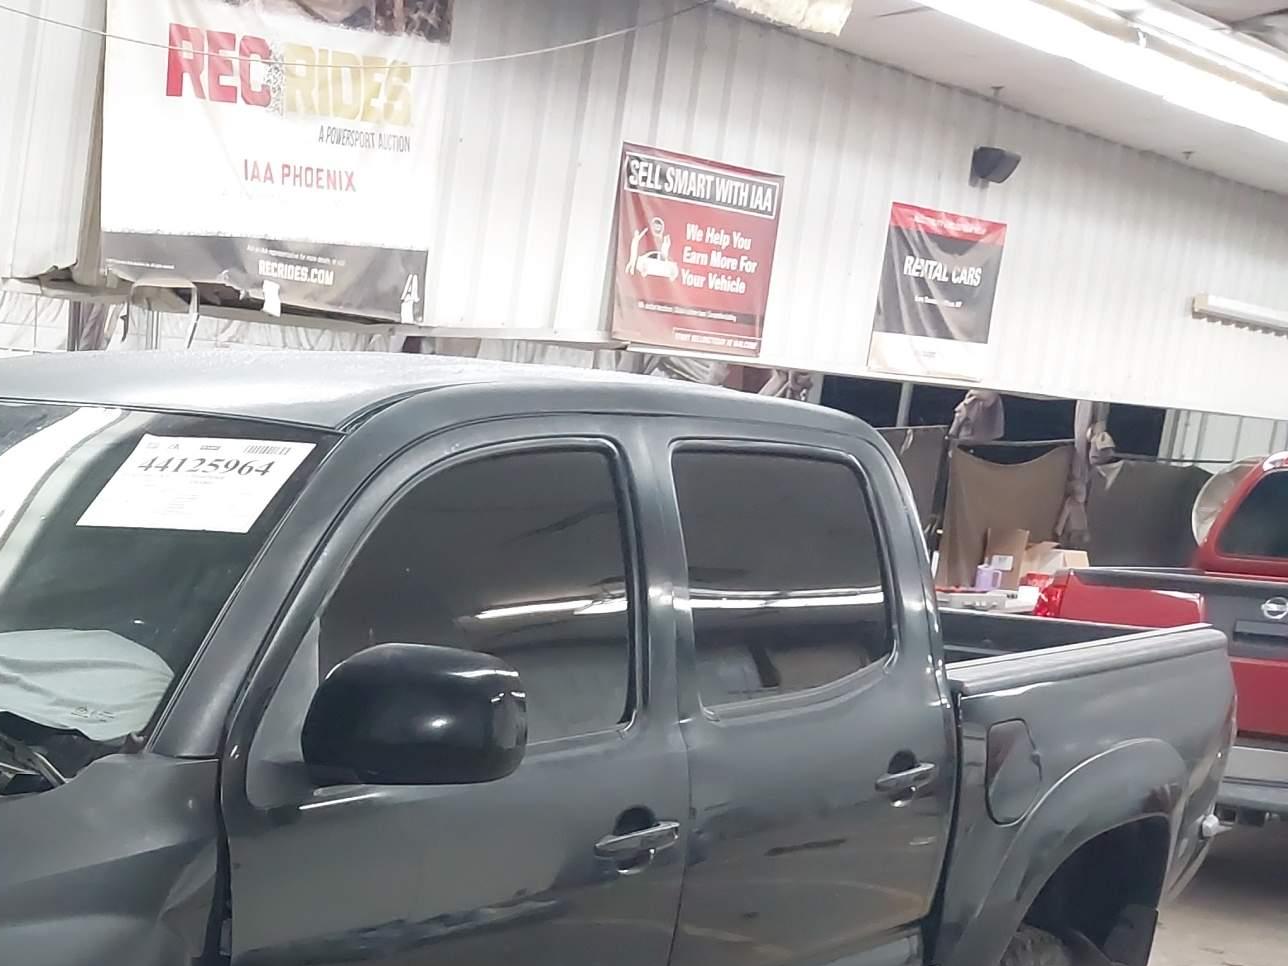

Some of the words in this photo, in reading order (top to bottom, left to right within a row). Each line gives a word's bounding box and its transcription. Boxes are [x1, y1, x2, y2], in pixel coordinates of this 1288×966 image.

[166, 23, 272, 108] REC
[283, 42, 412, 126] RIDES
[326, 126, 376, 149] POWERSPORT
[378, 132, 411, 153] AUCTION
[244, 159, 275, 185] IAA
[281, 163, 357, 192] PHOENIX
[629, 159, 662, 191] SELL
[665, 166, 714, 200] SMART
[715, 176, 750, 208] WITH
[751, 184, 773, 212] IAA
[686, 223, 704, 242] We
[705, 227, 731, 250] Help
[732, 231, 752, 250] You
[682, 246, 709, 266] Earn
[710, 250, 738, 271] More
[739, 255, 758, 273] For
[903, 256, 949, 282] RENTAL
[951, 266, 982, 286] CARS
[681, 268, 706, 288] Your
[708, 272, 746, 294] Vehicle
[138, 455, 276, 477] 44125964
